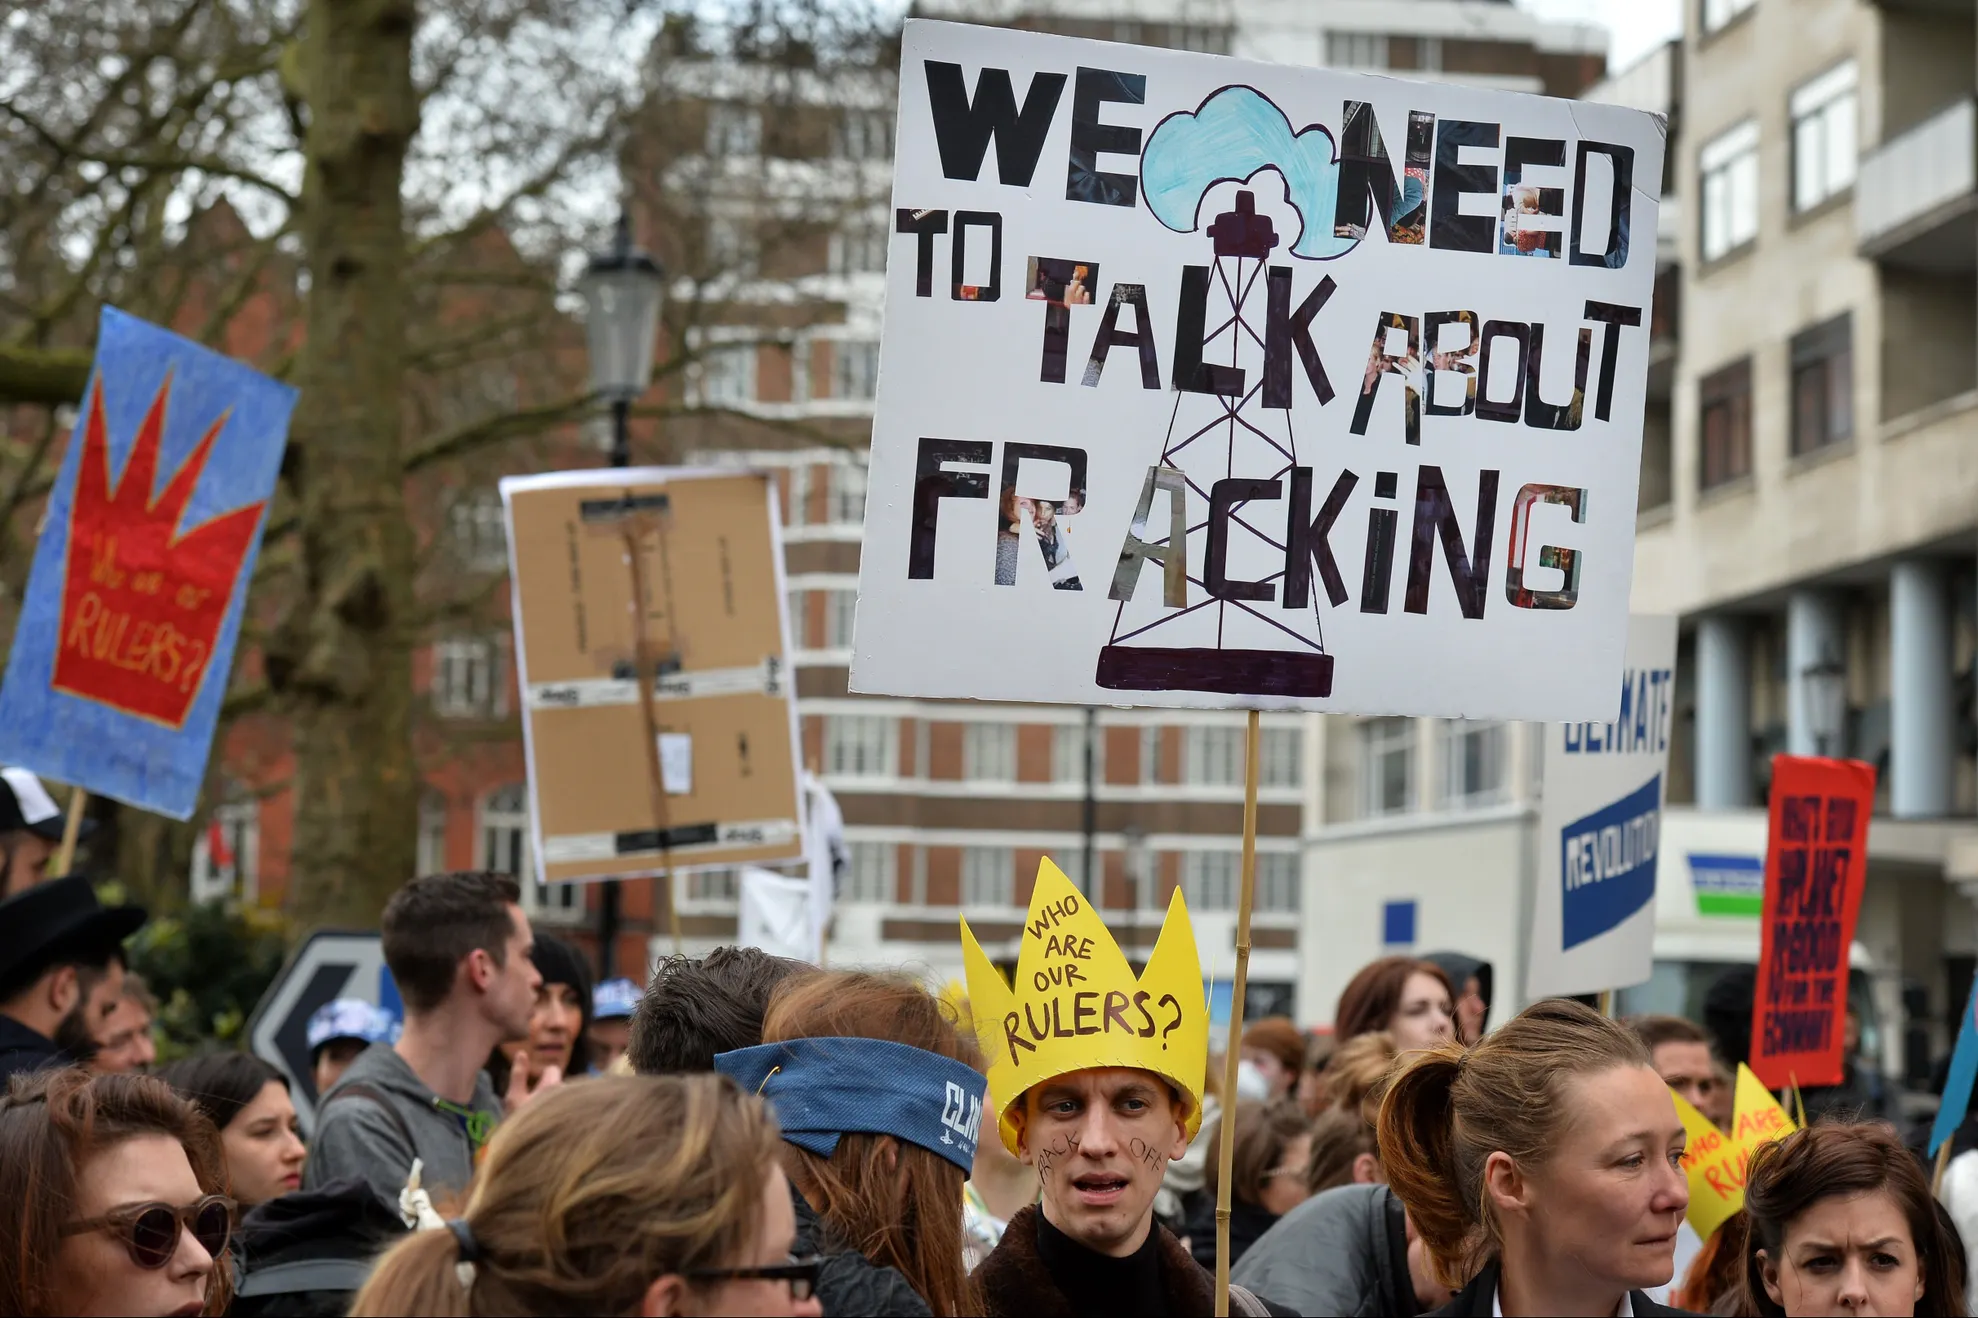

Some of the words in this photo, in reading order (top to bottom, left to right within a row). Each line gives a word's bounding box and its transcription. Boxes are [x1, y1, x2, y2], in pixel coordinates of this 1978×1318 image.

[924, 60, 1147, 208] WE
[1333, 100, 1635, 270] NEED
[896, 208, 1003, 302] TO
[1026, 256, 1338, 409] TALK
[1349, 300, 1642, 446] ABOUT
[67, 591, 206, 694] RULERS?
[1027, 895, 1079, 940] WHO
[1044, 934, 1095, 960] ARE
[1033, 963, 1087, 992] OUR
[1003, 990, 1182, 1067] RULERS?
[941, 1080, 983, 1151] CLIM
[1737, 1107, 1784, 1140] ARE
[1037, 1130, 1080, 1185] FRACK
[1130, 1137, 1162, 1171] OFF
